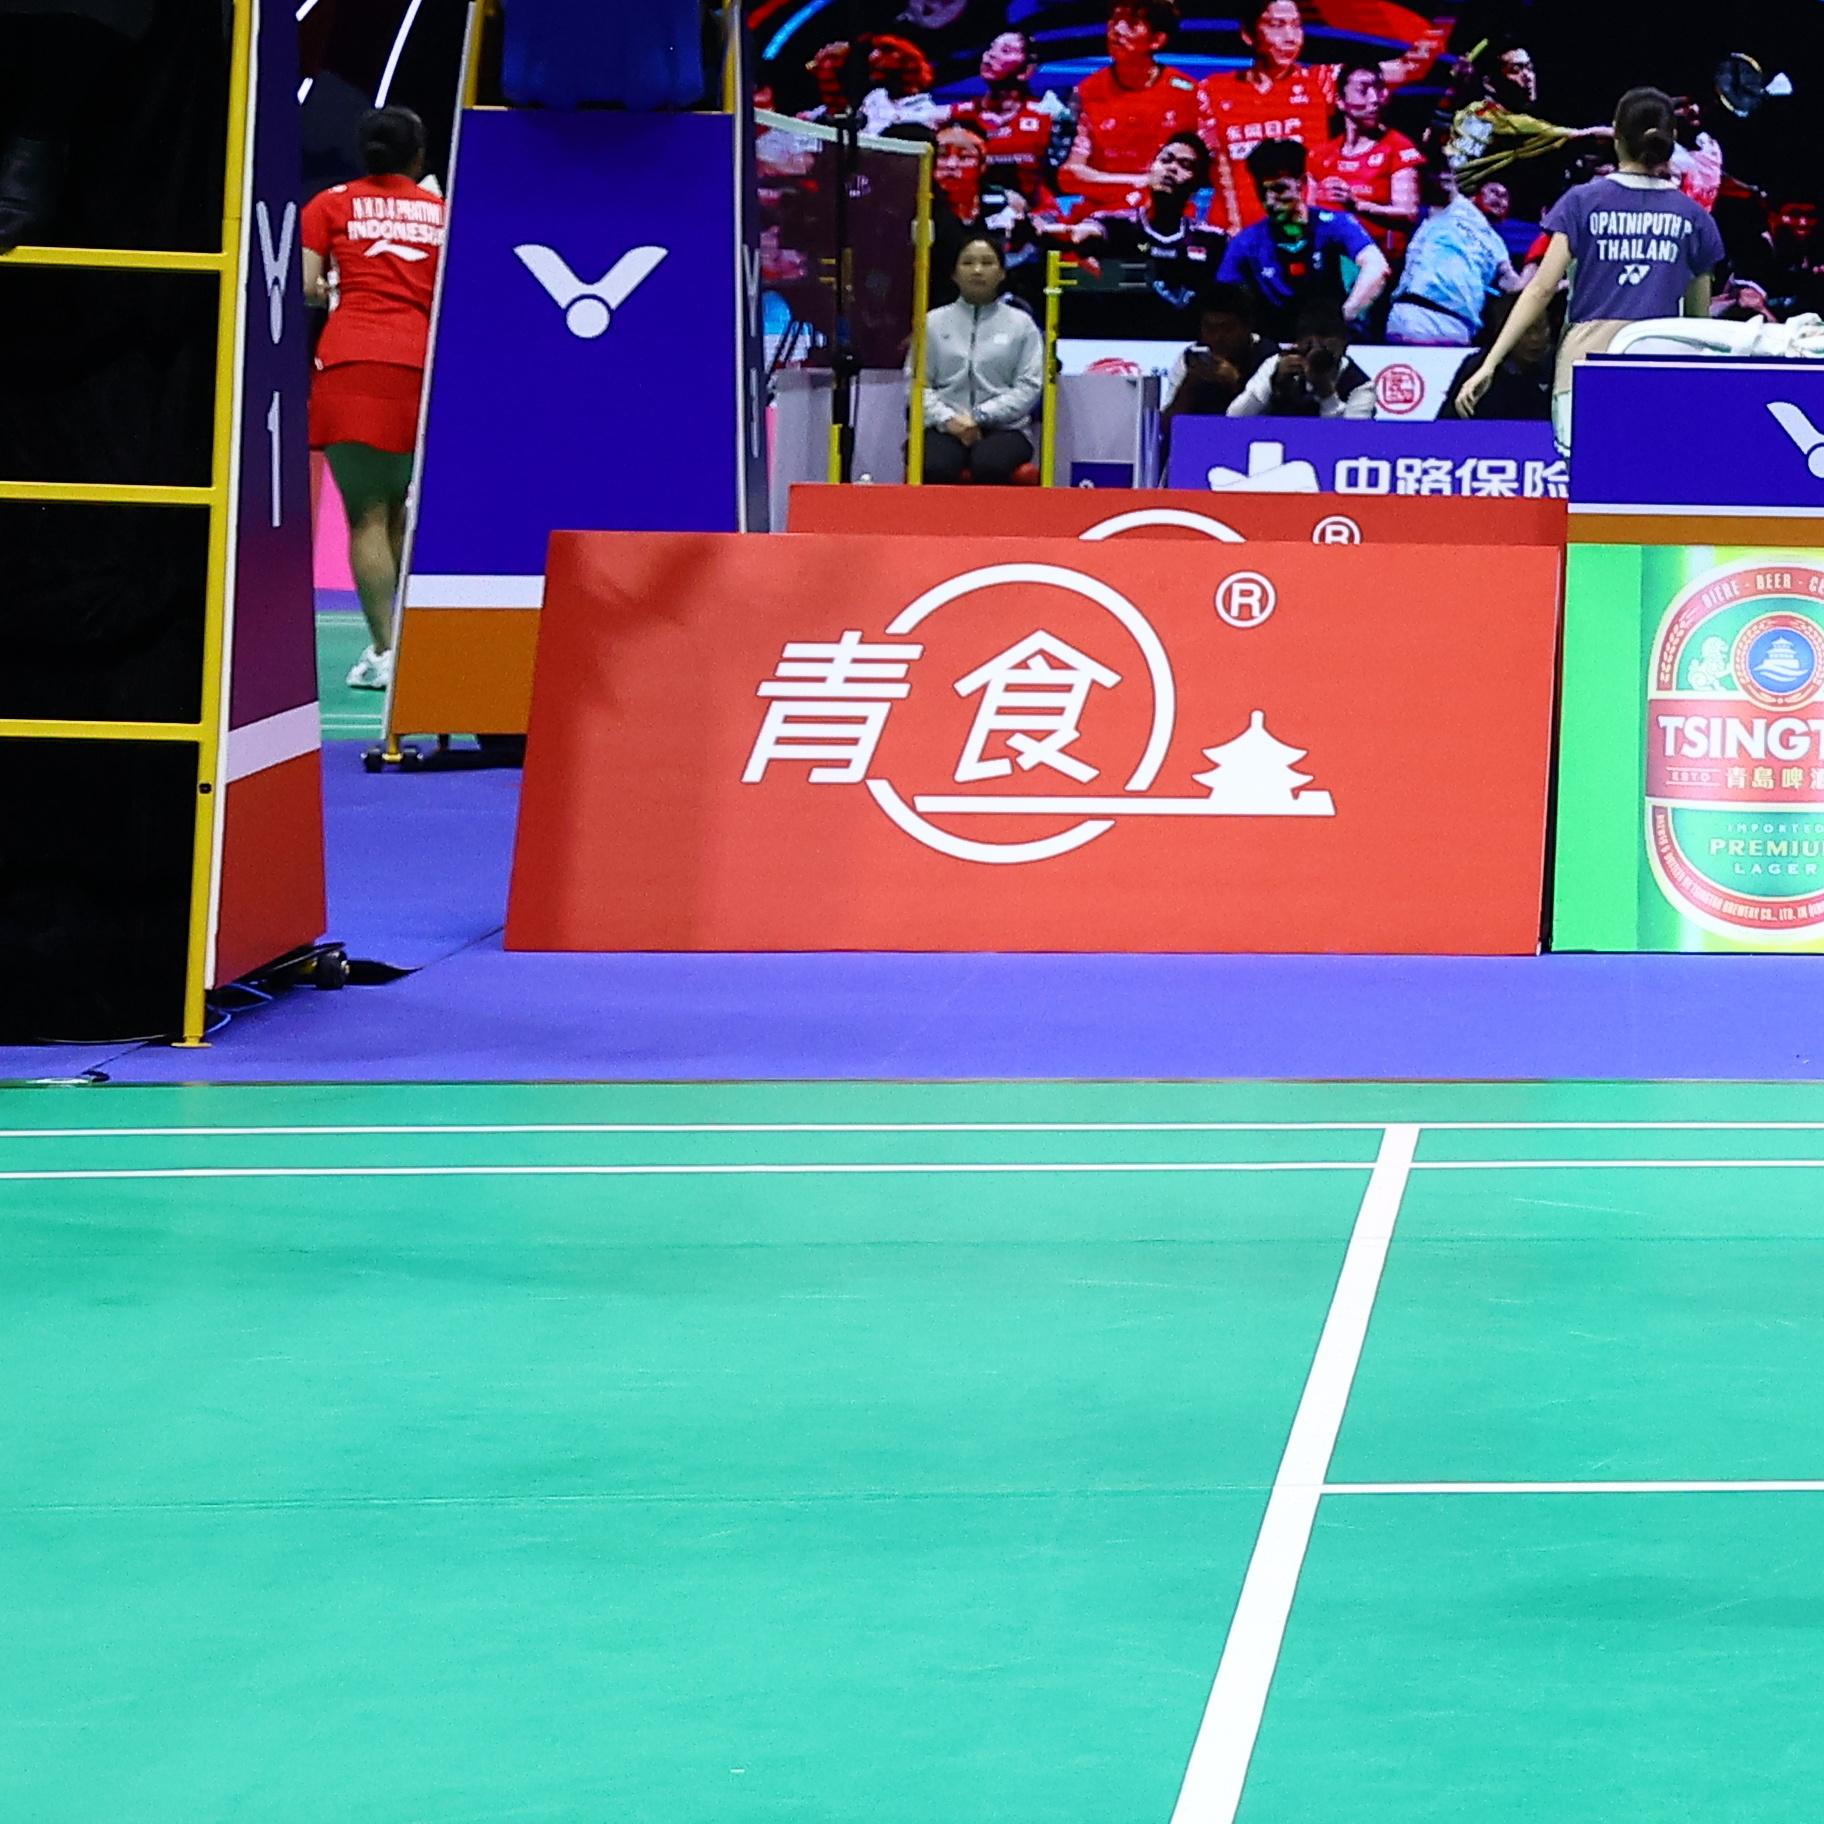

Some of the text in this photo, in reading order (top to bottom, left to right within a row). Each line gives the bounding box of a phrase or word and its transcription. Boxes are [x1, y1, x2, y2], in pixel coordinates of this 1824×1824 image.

[1589, 210, 1681, 239] OPATNIPUTH
[1596, 238, 1679, 263] THAILAND
[1755, 573, 1792, 592] BEER
[741, 629, 1123, 786] 青食
[1733, 862, 1819, 875] LAGER
